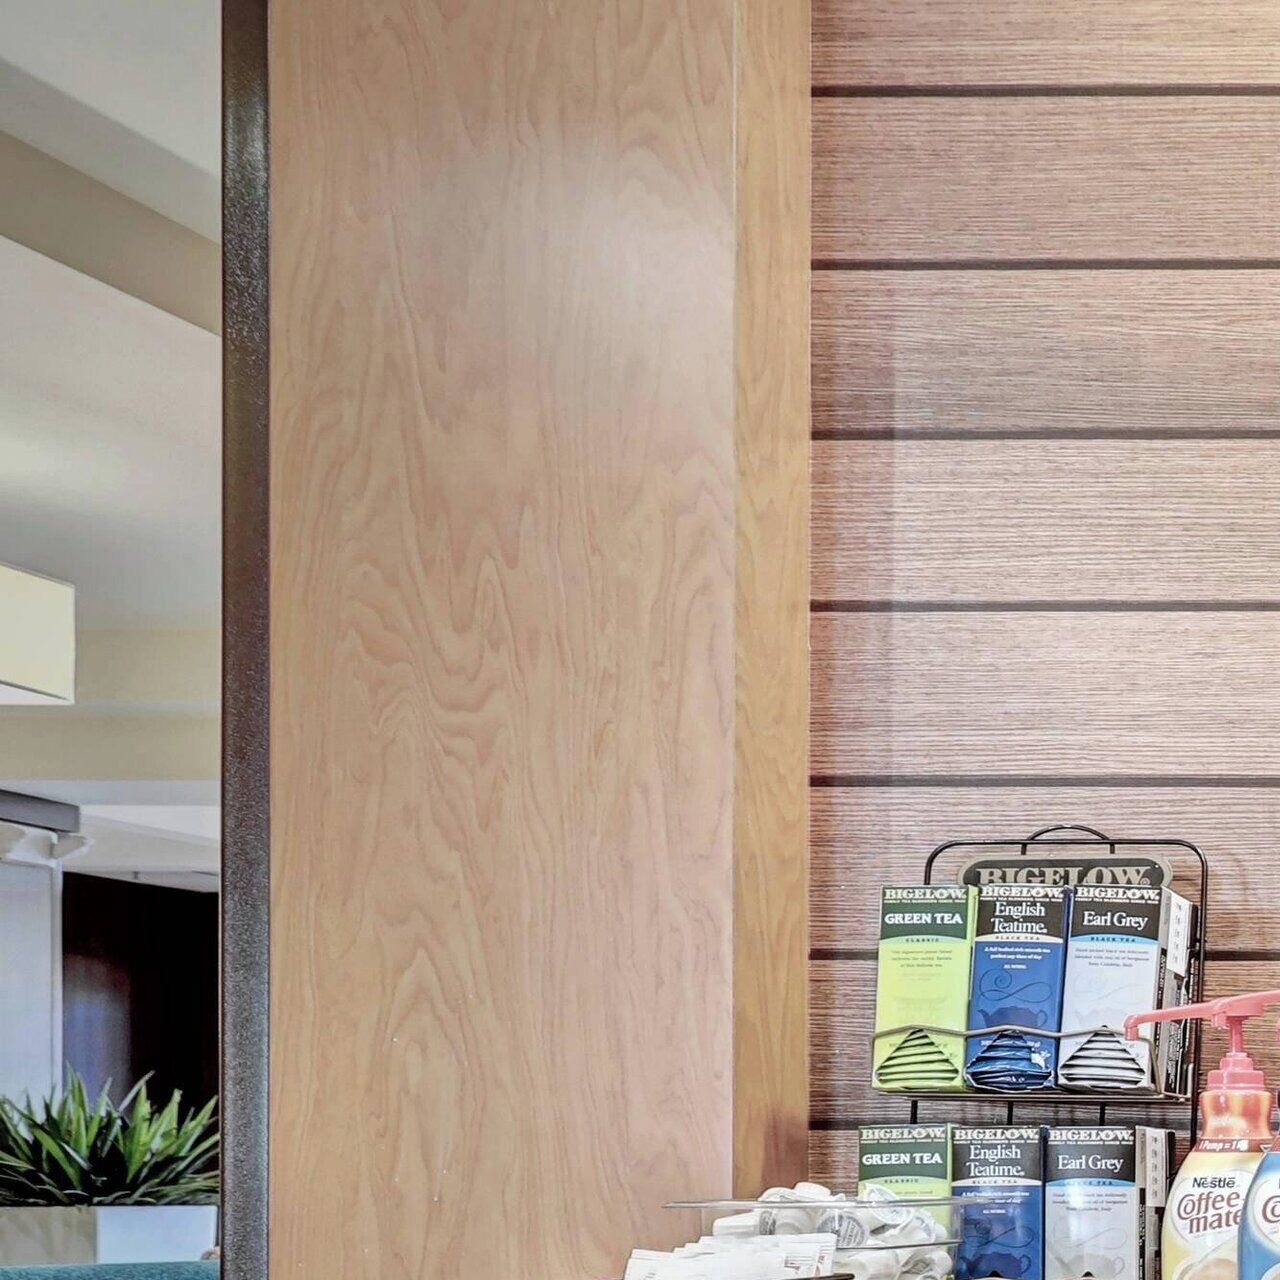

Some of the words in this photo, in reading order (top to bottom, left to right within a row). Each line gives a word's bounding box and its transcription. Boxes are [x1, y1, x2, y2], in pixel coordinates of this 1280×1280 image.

[884, 913, 932, 924] GREEN
[934, 913, 963, 924] TEA
[994, 901, 1045, 919] English
[1083, 911, 1111, 926] Earl
[1113, 912, 1148, 931] Grey
[969, 1144, 1021, 1162] English
[1203, 1140, 1224, 1151] Pump
[862, 1153, 910, 1165] GREEN
[913, 1152, 943, 1164] TEA
[1057, 1154, 1086, 1169] Earl
[1088, 1154, 1124, 1173] Grey
[1177, 1191, 1240, 1220] Coffee
[1189, 1208, 1242, 1234] mate
